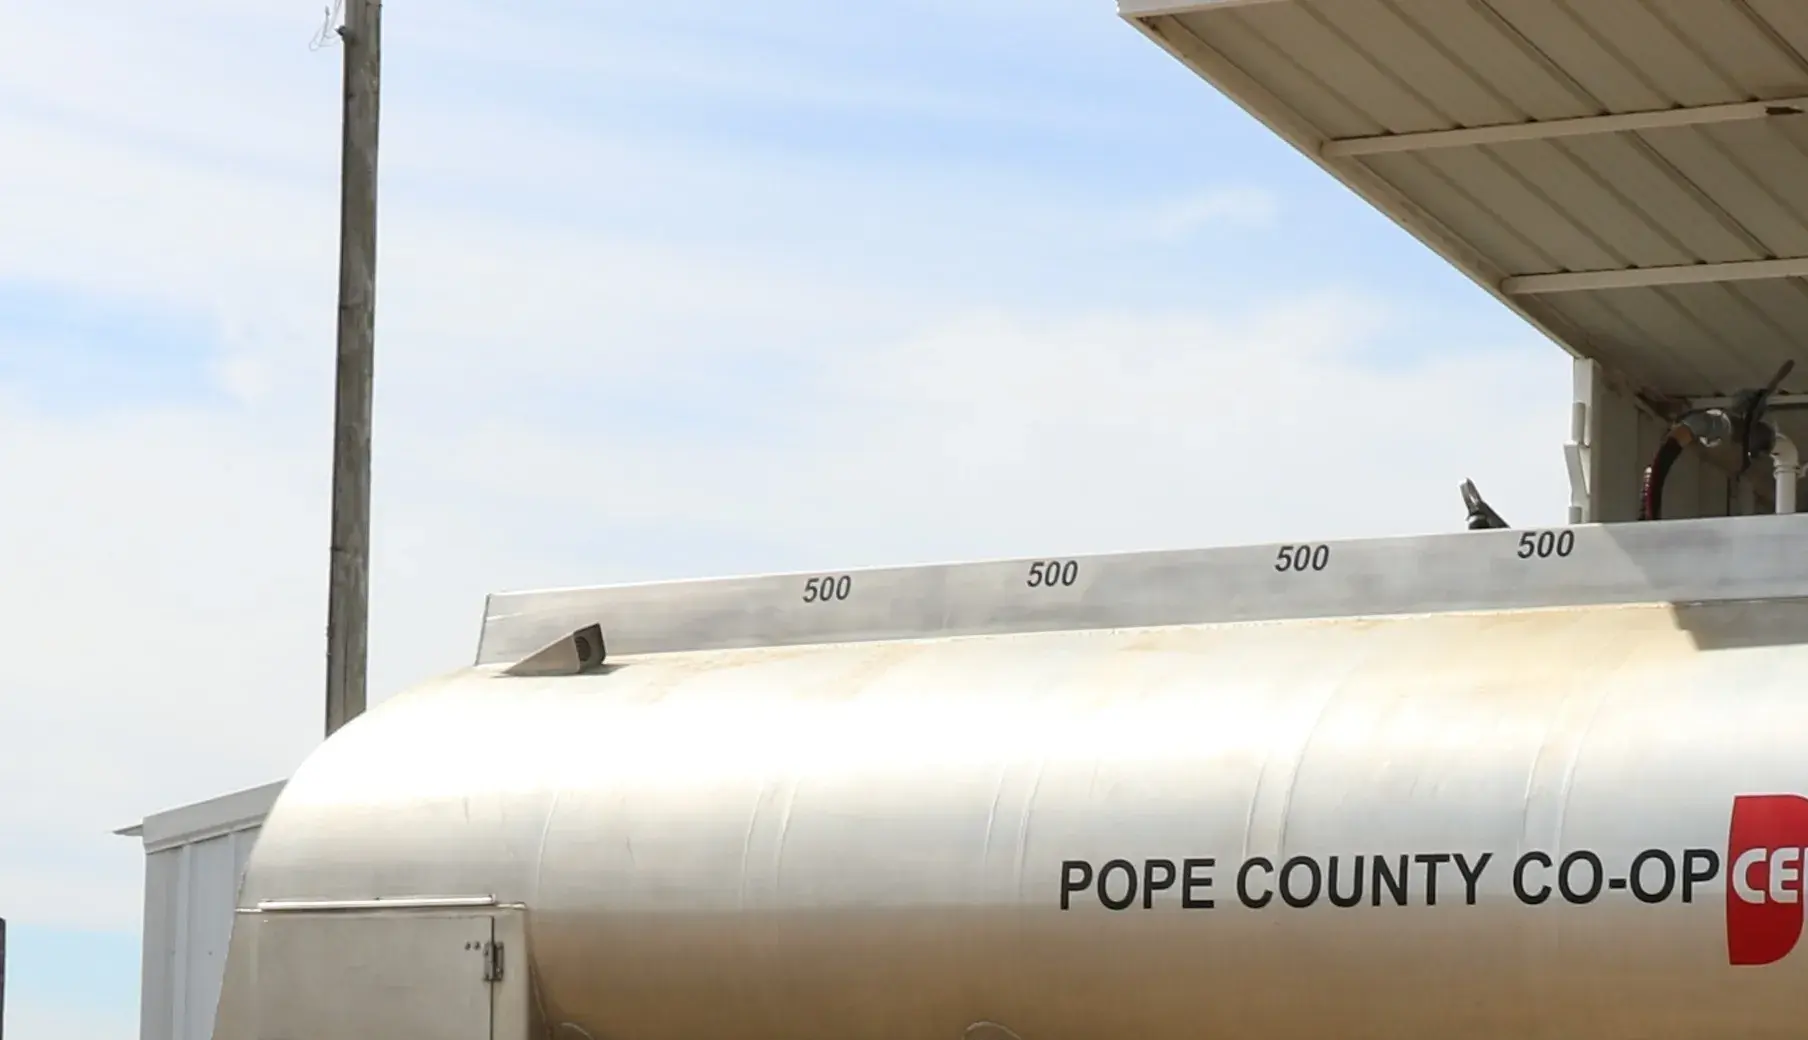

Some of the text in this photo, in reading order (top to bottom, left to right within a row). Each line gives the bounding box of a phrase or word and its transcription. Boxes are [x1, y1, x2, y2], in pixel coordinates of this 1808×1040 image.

[802, 575, 852, 603] 500
[1027, 560, 1078, 587] 500
[1275, 544, 1330, 572] 500
[1517, 530, 1575, 559] 500
[1060, 849, 1720, 911] POPE COUNTY CO-OP
